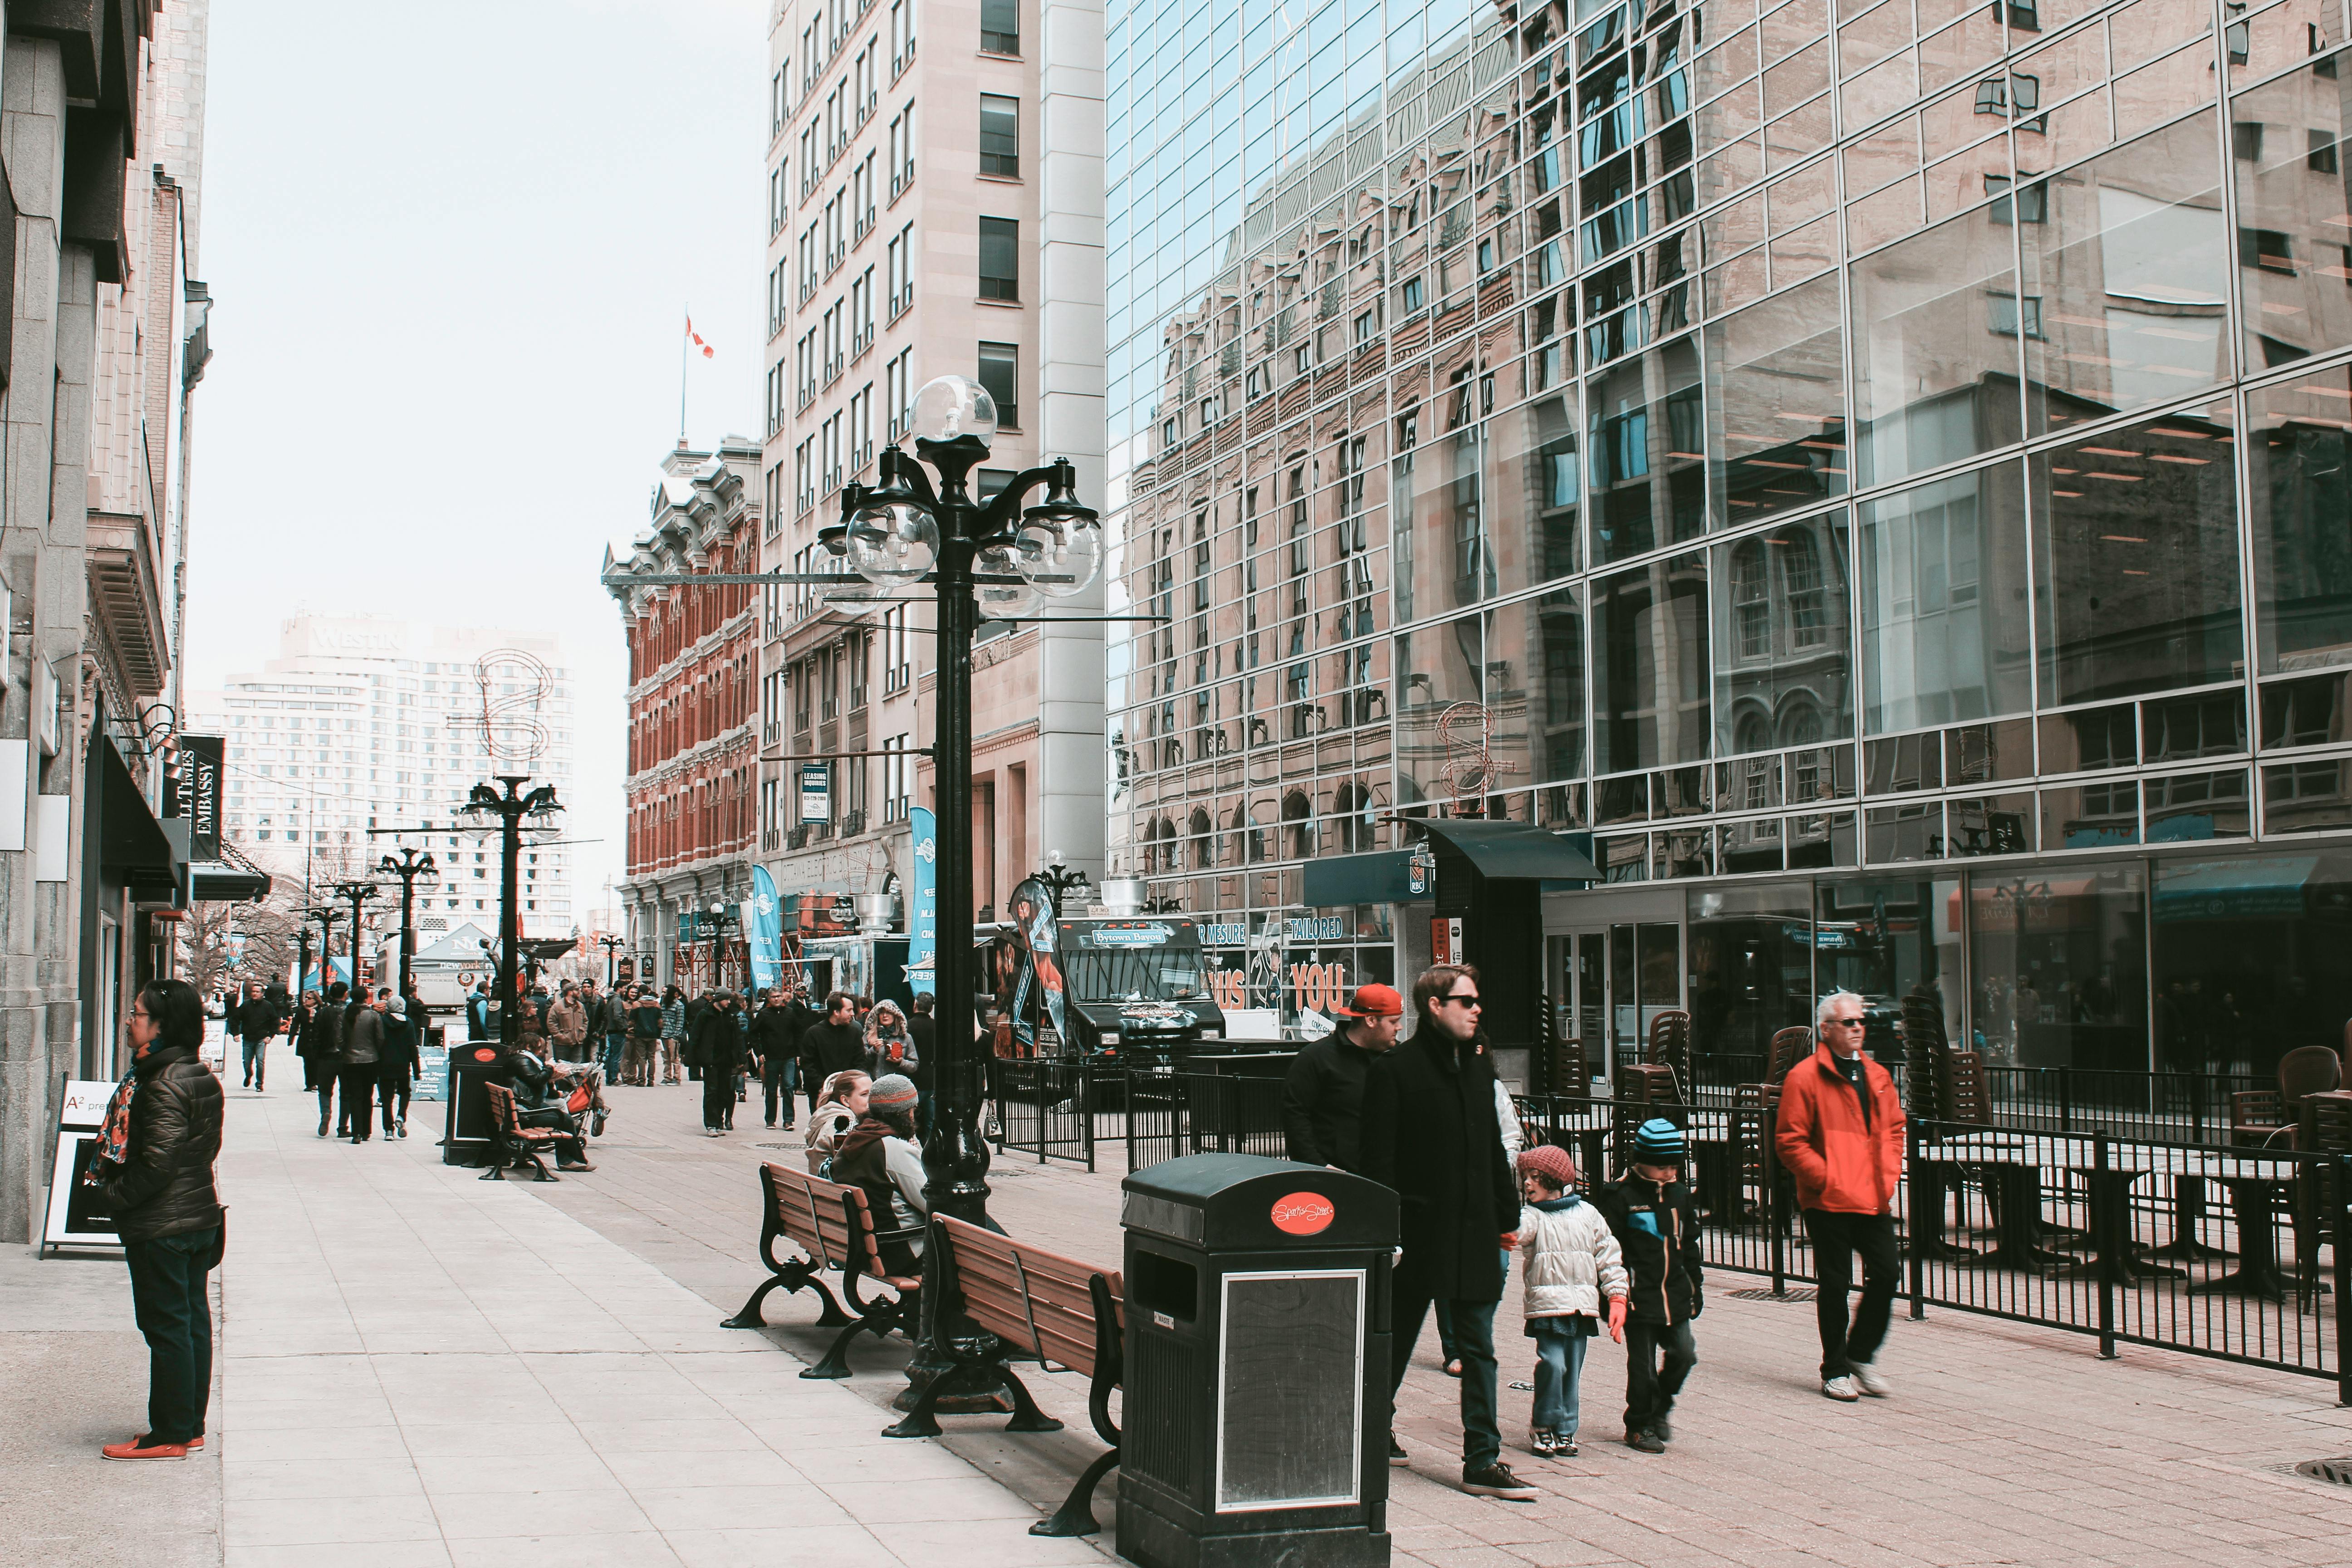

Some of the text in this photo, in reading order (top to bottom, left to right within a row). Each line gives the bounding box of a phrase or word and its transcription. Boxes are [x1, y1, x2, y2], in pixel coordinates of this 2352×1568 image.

[312, 627, 401, 650] WESTIN
[196, 761, 213, 835] EMBASSY
[784, 863, 805, 881] OTTAWA
[807, 855, 836, 878] ELECTRIC
[1412, 882, 1423, 890] RBC
[1096, 932, 1162, 943] Bytown Bayou
[1207, 923, 1245, 945] MESURE
[1290, 916, 1343, 941] TAILORED
[1290, 963, 1343, 1014] YOU
[1275, 1204, 1330, 1222] Sparks Street
[1158, 1315, 1169, 1325] WASTE
